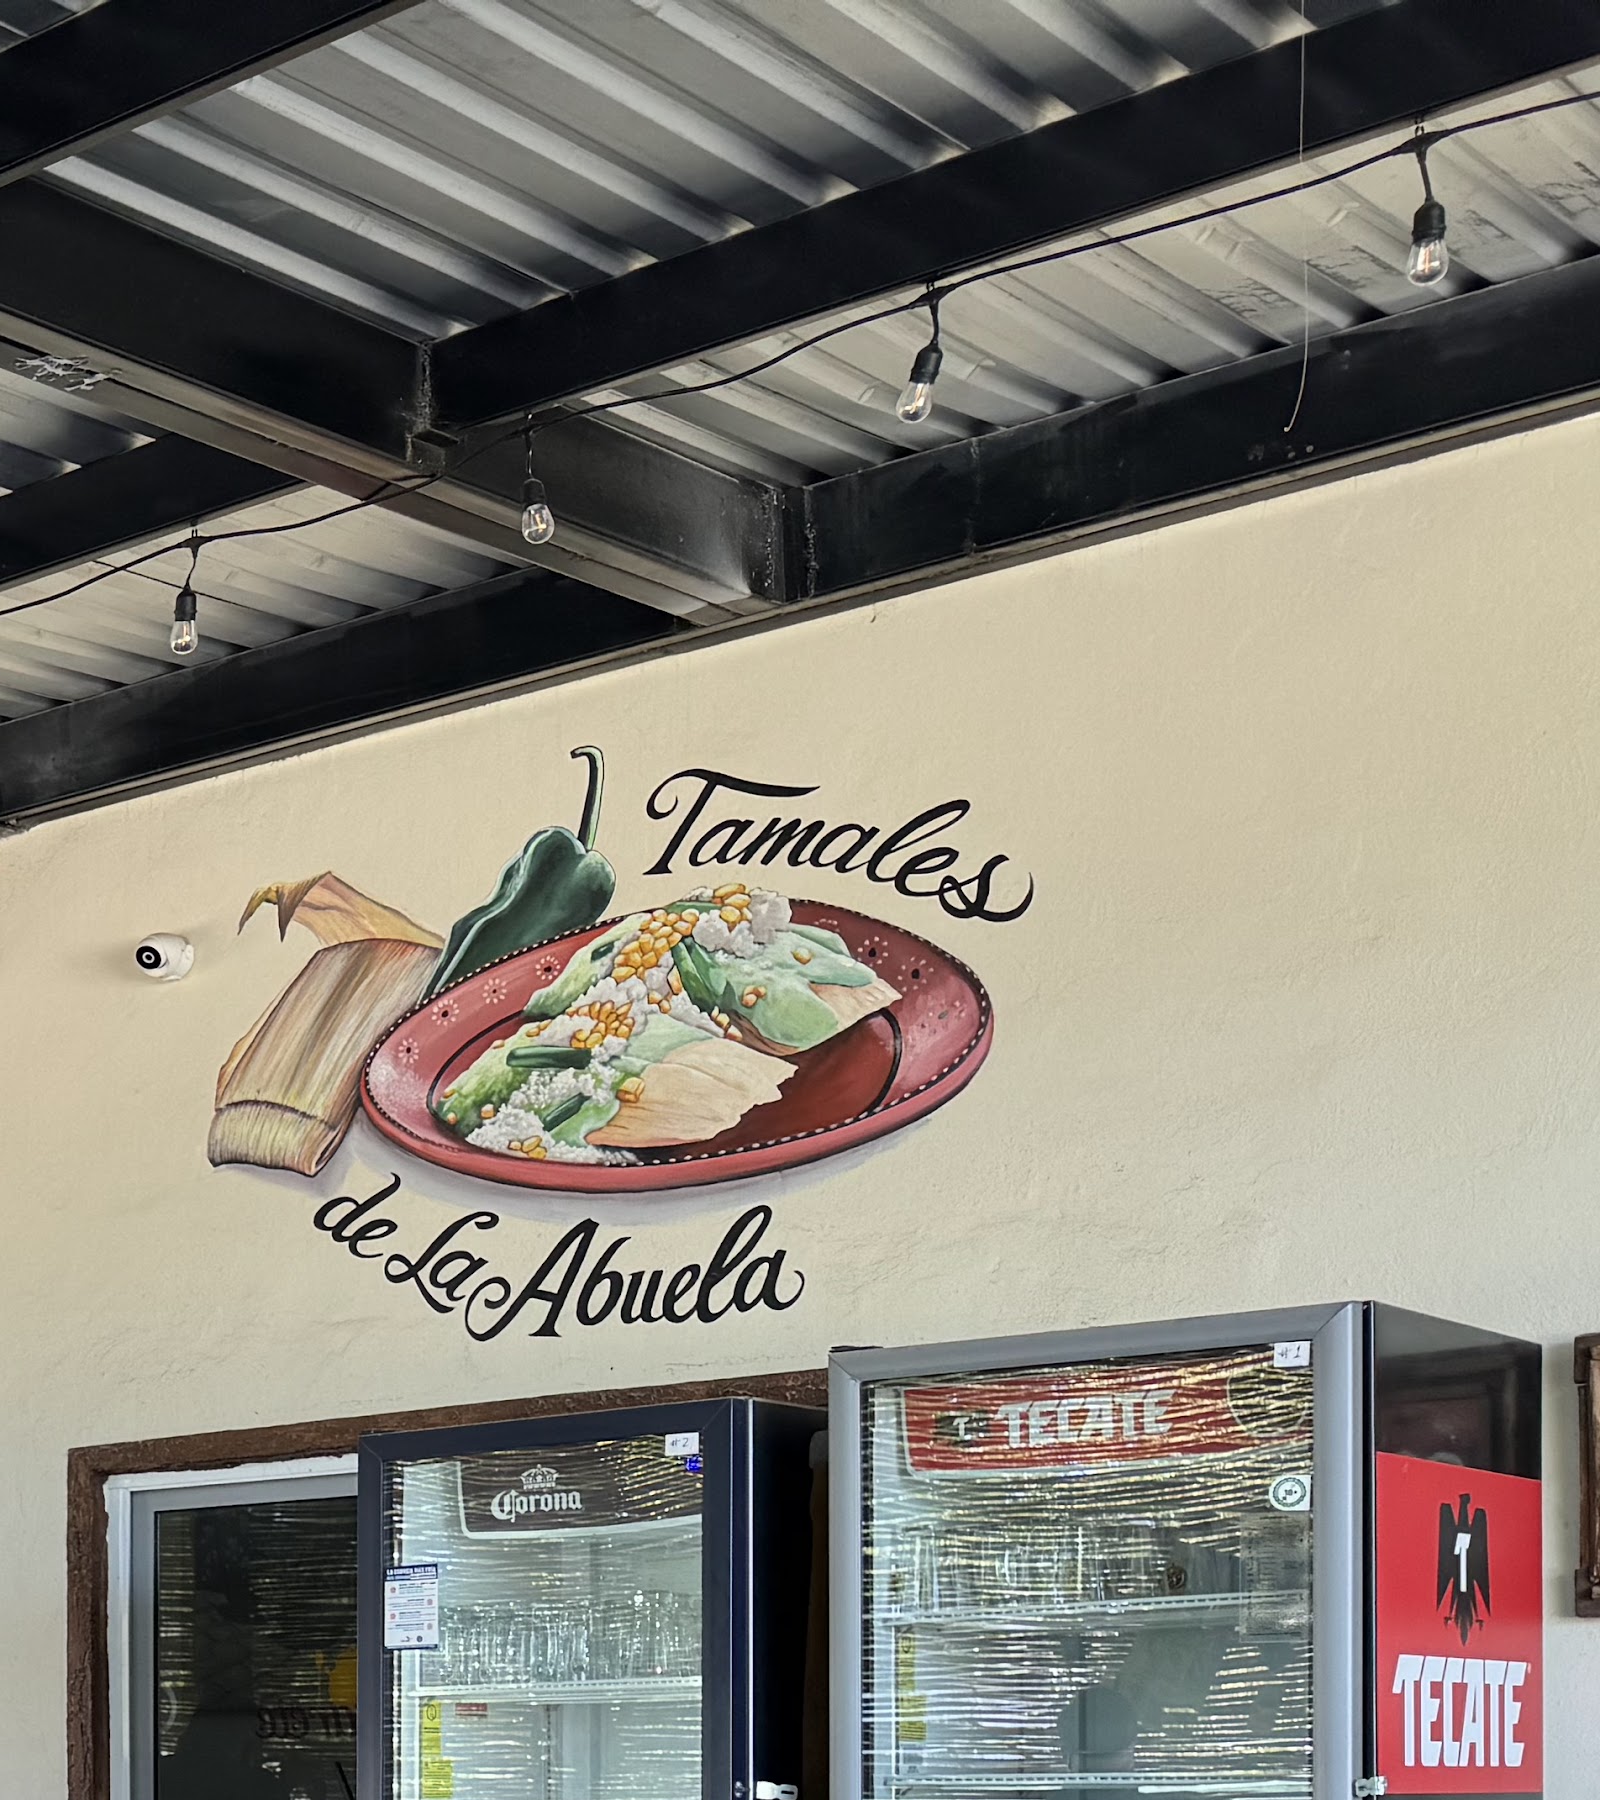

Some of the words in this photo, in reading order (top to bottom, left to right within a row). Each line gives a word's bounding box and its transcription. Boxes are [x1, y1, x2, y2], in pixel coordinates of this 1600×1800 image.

[643, 768, 1036, 924] Tamales
[312, 1175, 402, 1259] de
[384, 1211, 501, 1314] La
[465, 1205, 805, 1342] Abuela
[1000, 1388, 1178, 1449] TECATE
[490, 1489, 584, 1523] Corona
[1392, 1654, 1528, 1767] TECATE
